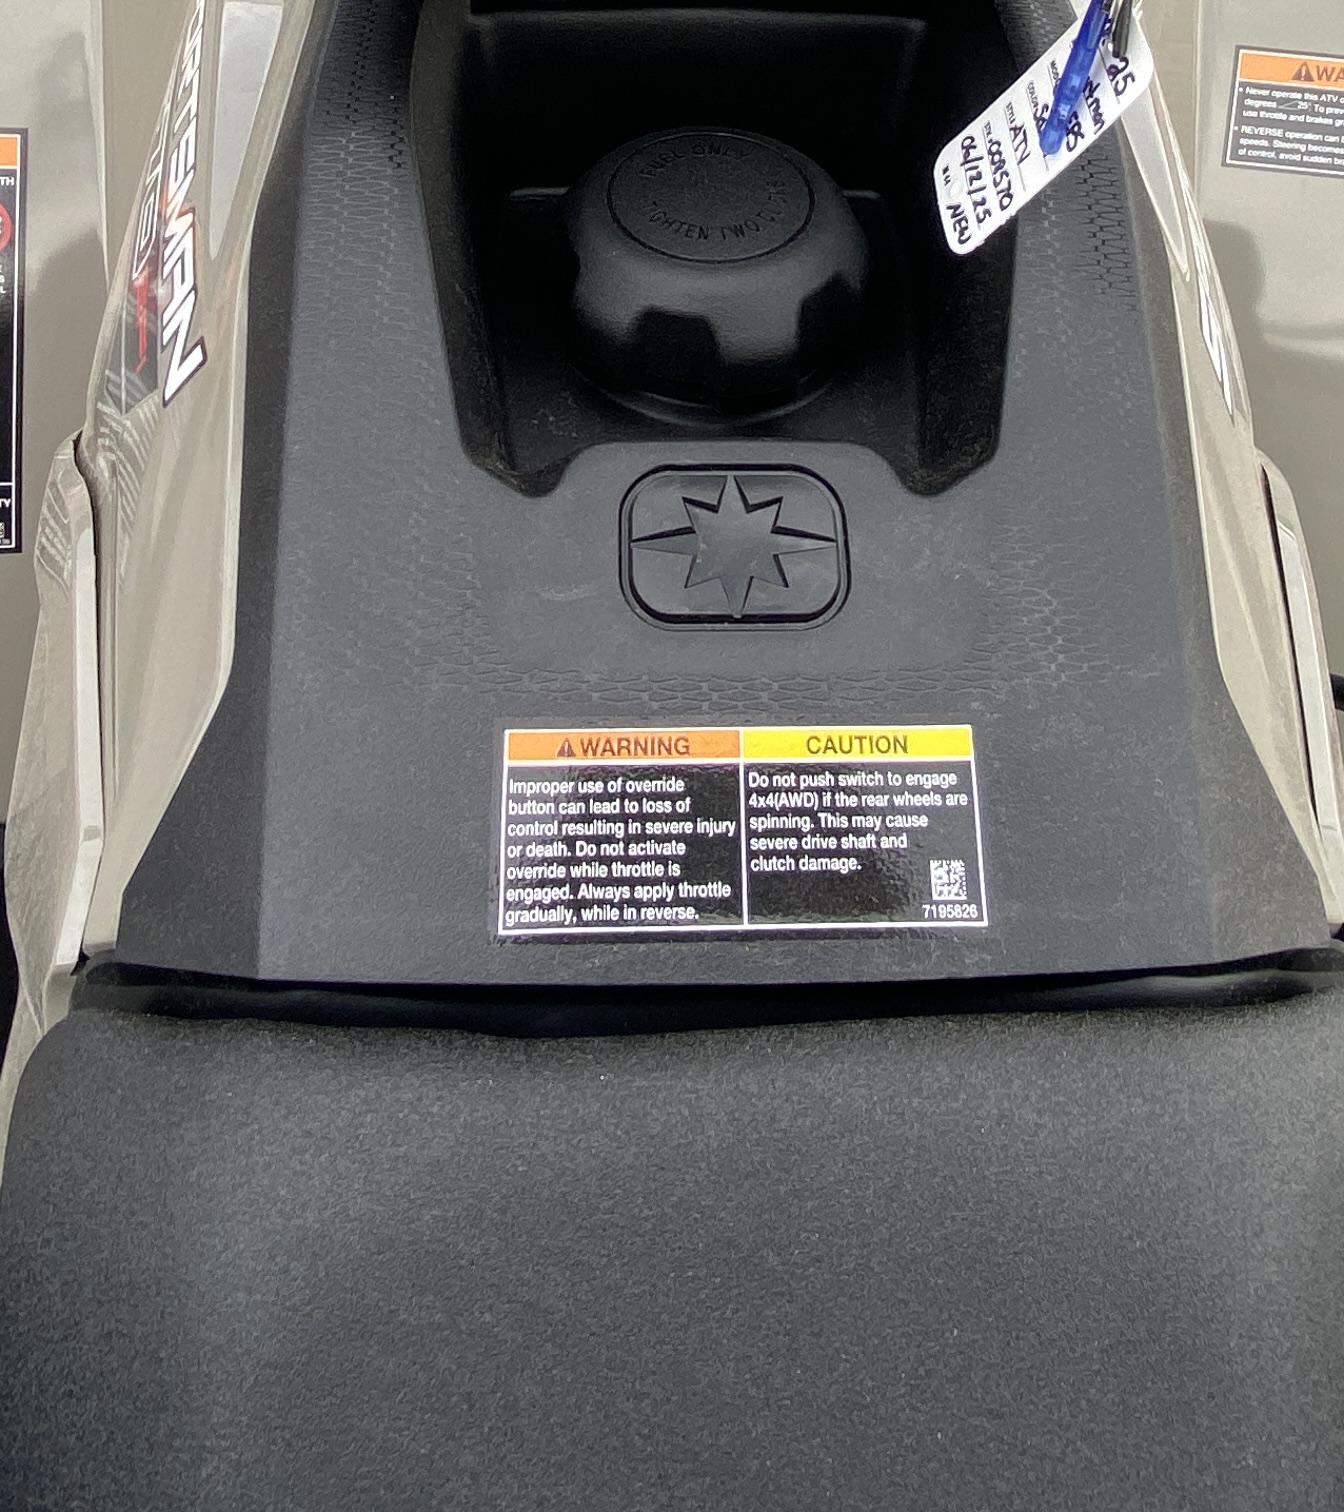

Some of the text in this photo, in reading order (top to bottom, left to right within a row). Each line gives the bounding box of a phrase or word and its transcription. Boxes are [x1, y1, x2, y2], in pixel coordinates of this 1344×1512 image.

[946, 201, 971, 246] NEW
[580, 736, 691, 757] WARNING
[805, 734, 909, 755] CAUTION
[509, 776, 685, 797] Improper use of override
[748, 771, 957, 790] Do not push switch to engage
[508, 797, 692, 815] button can lead to loss of
[748, 790, 969, 811] 4x4(AWD) if the rear wheels are
[507, 818, 736, 838] control resulting in severe injury
[749, 812, 929, 833] spinning. This may cause
[507, 840, 686, 858] or death. Do not activate
[749, 833, 908, 850] severe drive shaft and
[506, 860, 681, 880] override while throttle is
[750, 854, 862, 874] clutch damage.
[506, 881, 732, 904] engaged. Always apply throttle
[505, 904, 700, 926] gradually, while in reverse.
[922, 904, 978, 919] 7195826
